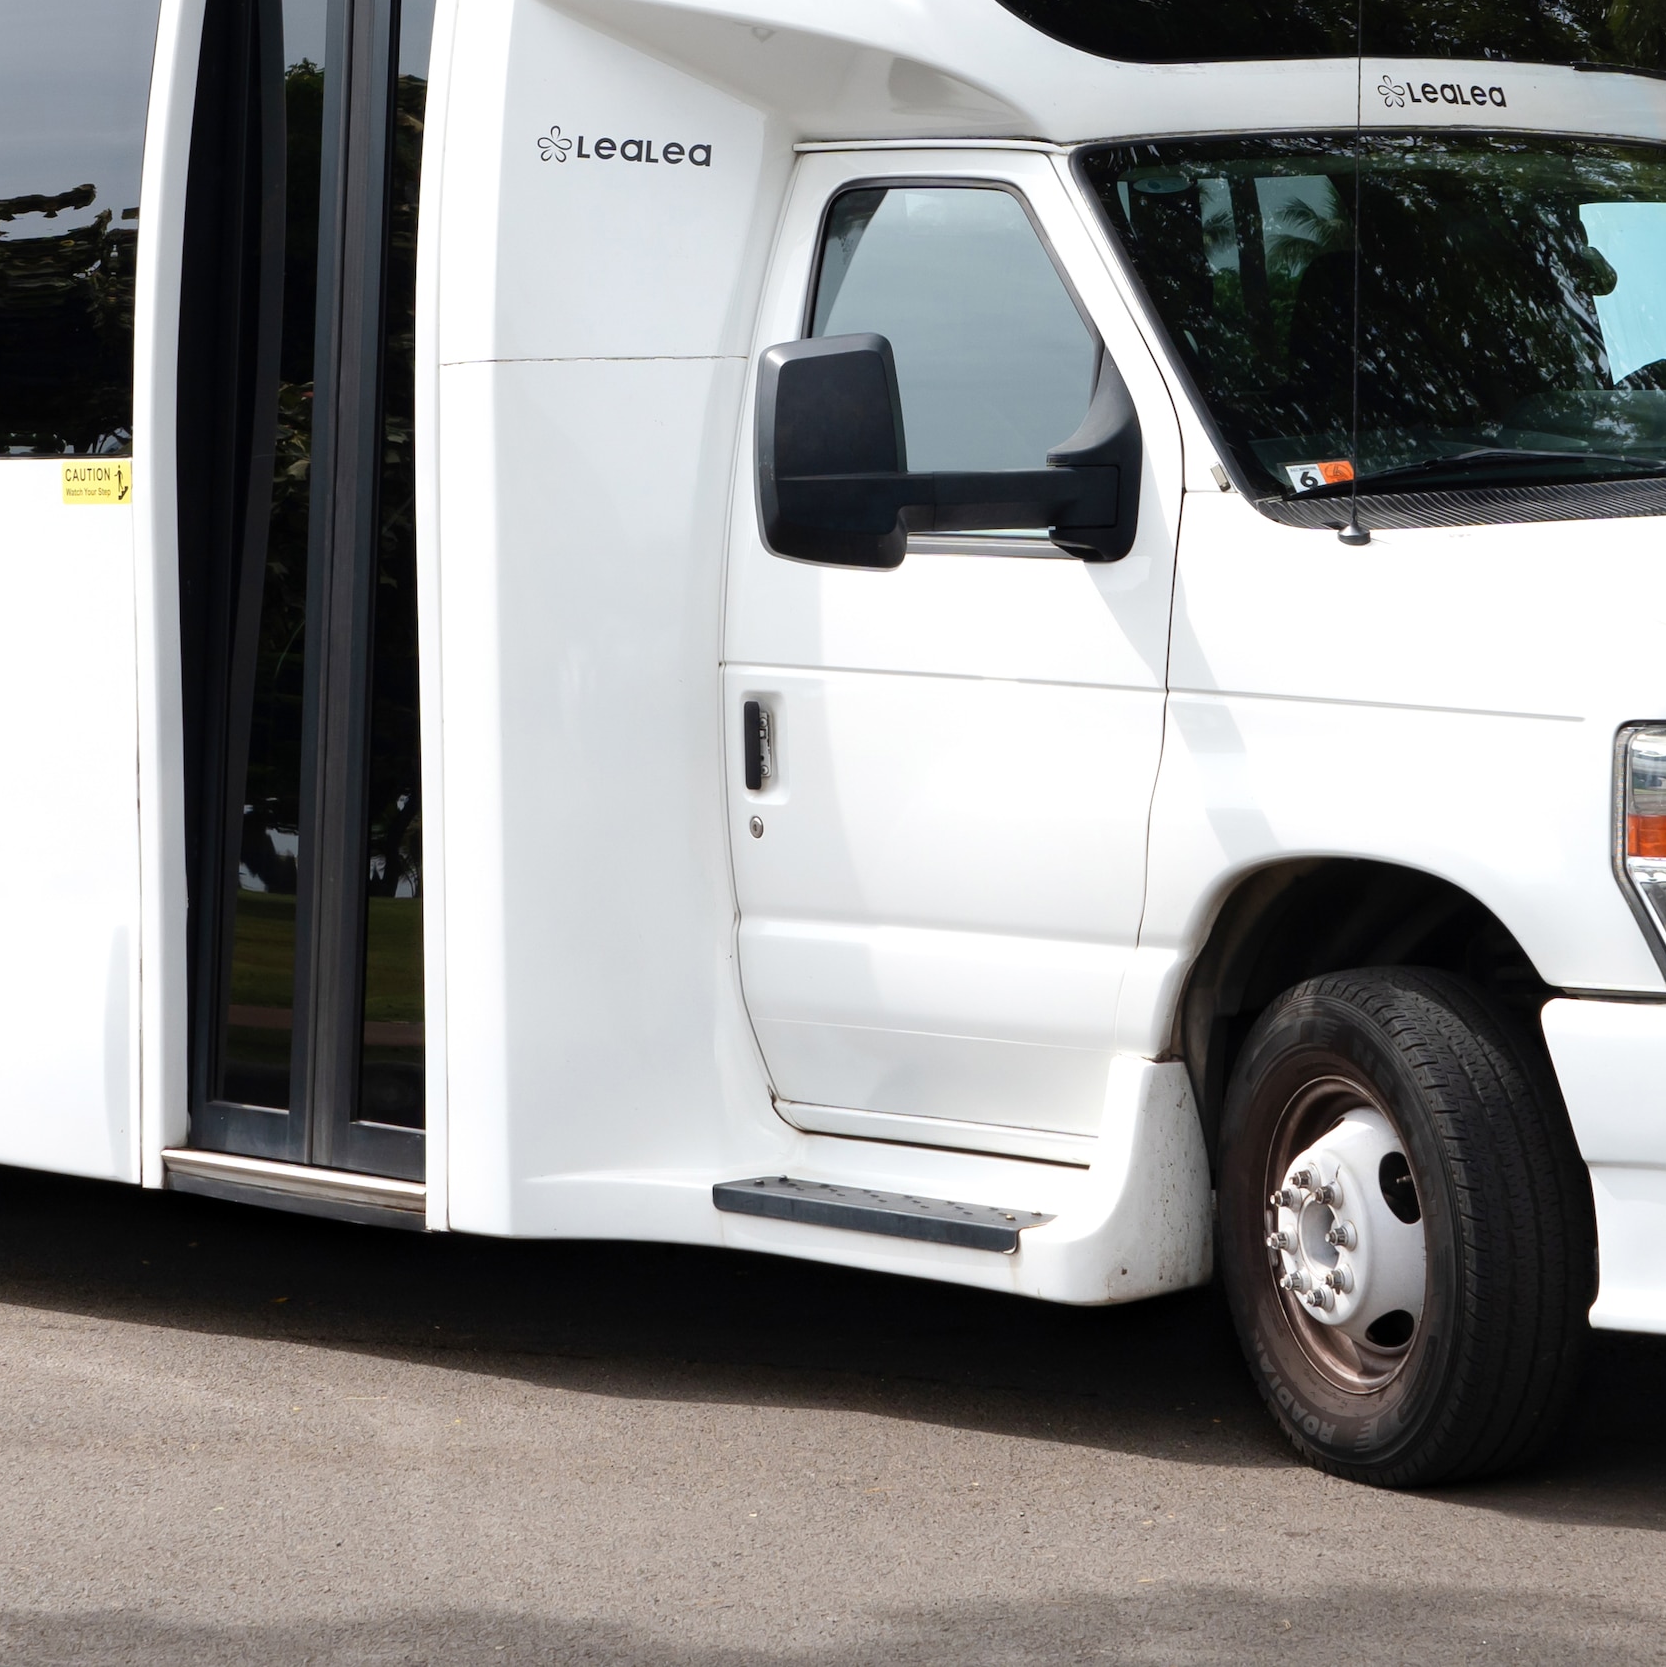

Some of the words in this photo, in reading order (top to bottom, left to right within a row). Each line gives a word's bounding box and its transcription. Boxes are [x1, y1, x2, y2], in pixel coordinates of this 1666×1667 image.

[65, 468, 110, 481] CAUTION
[1300, 471, 1318, 487] 6
[66, 488, 83, 496] Watch
[84, 488, 97, 496] Your
[98, 488, 111, 497] Step
